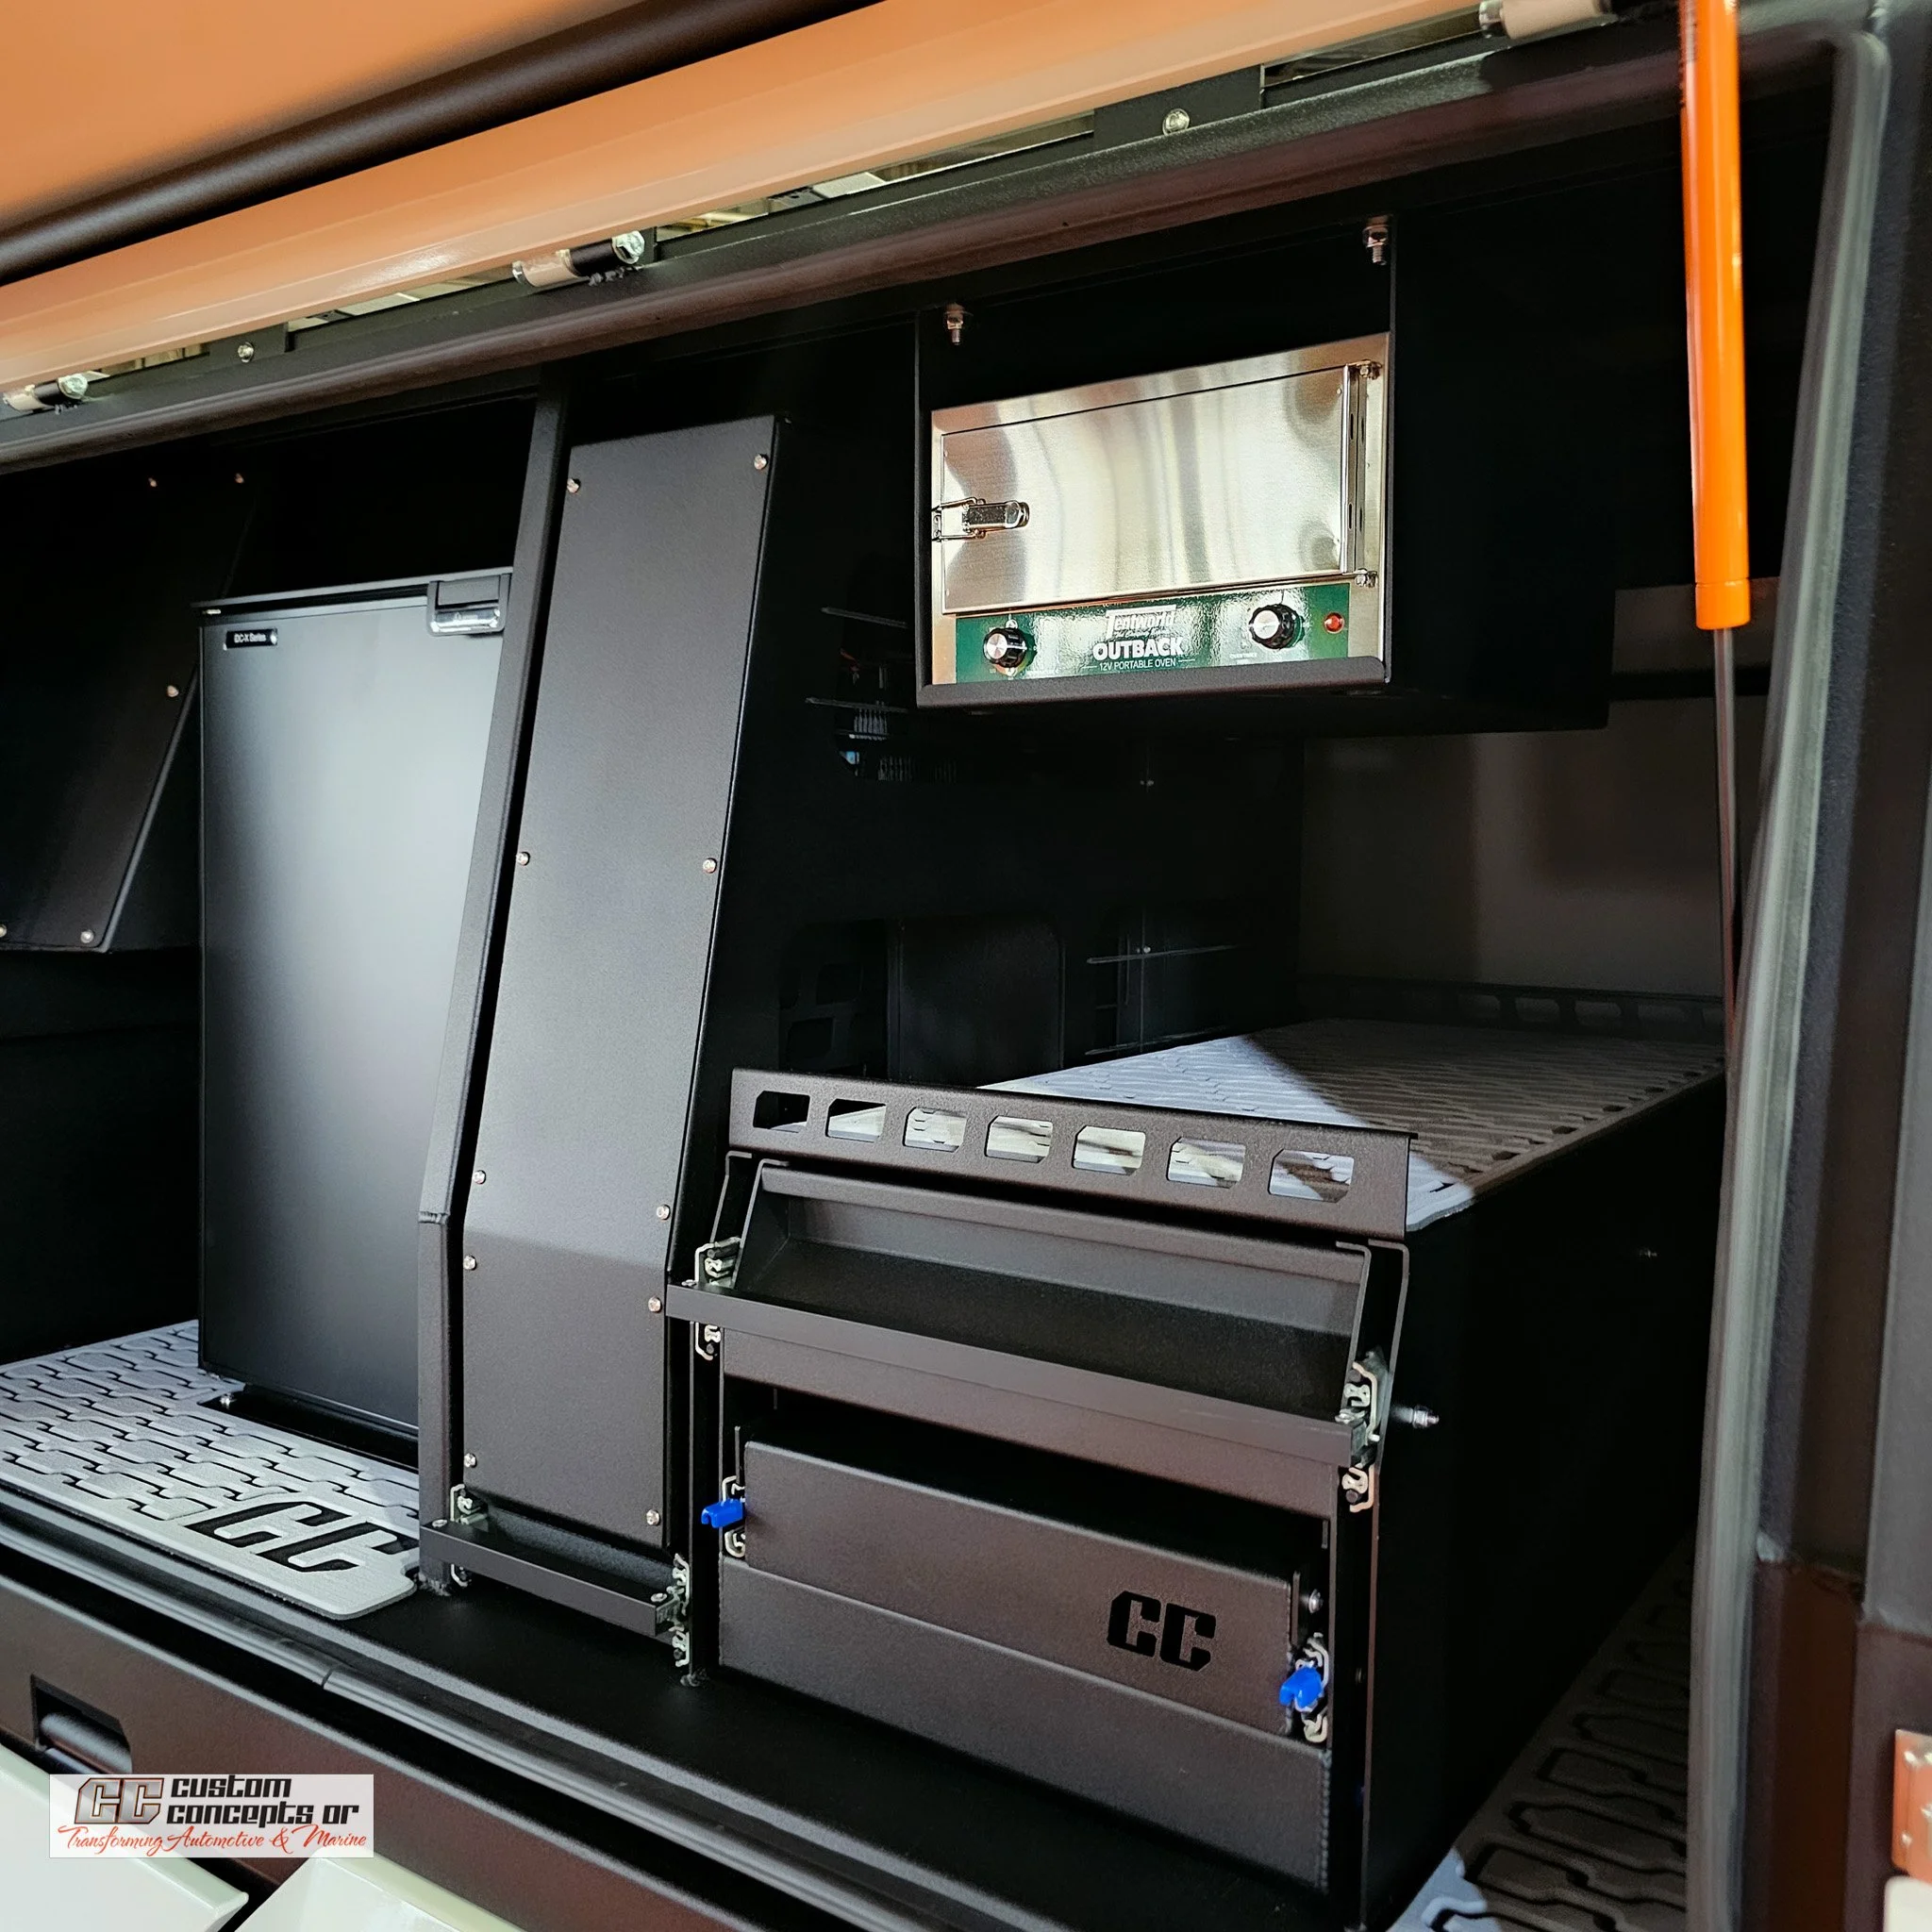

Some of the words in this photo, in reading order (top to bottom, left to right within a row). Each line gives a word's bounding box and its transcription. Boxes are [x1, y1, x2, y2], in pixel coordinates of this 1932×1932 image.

[1093, 637, 1184, 660] OUTBACK
[1099, 662, 1112, 671] 12V
[1114, 659, 1153, 670] PORTABLE
[1155, 658, 1176, 668] OVEN
[1107, 1591, 1216, 1672] CC
